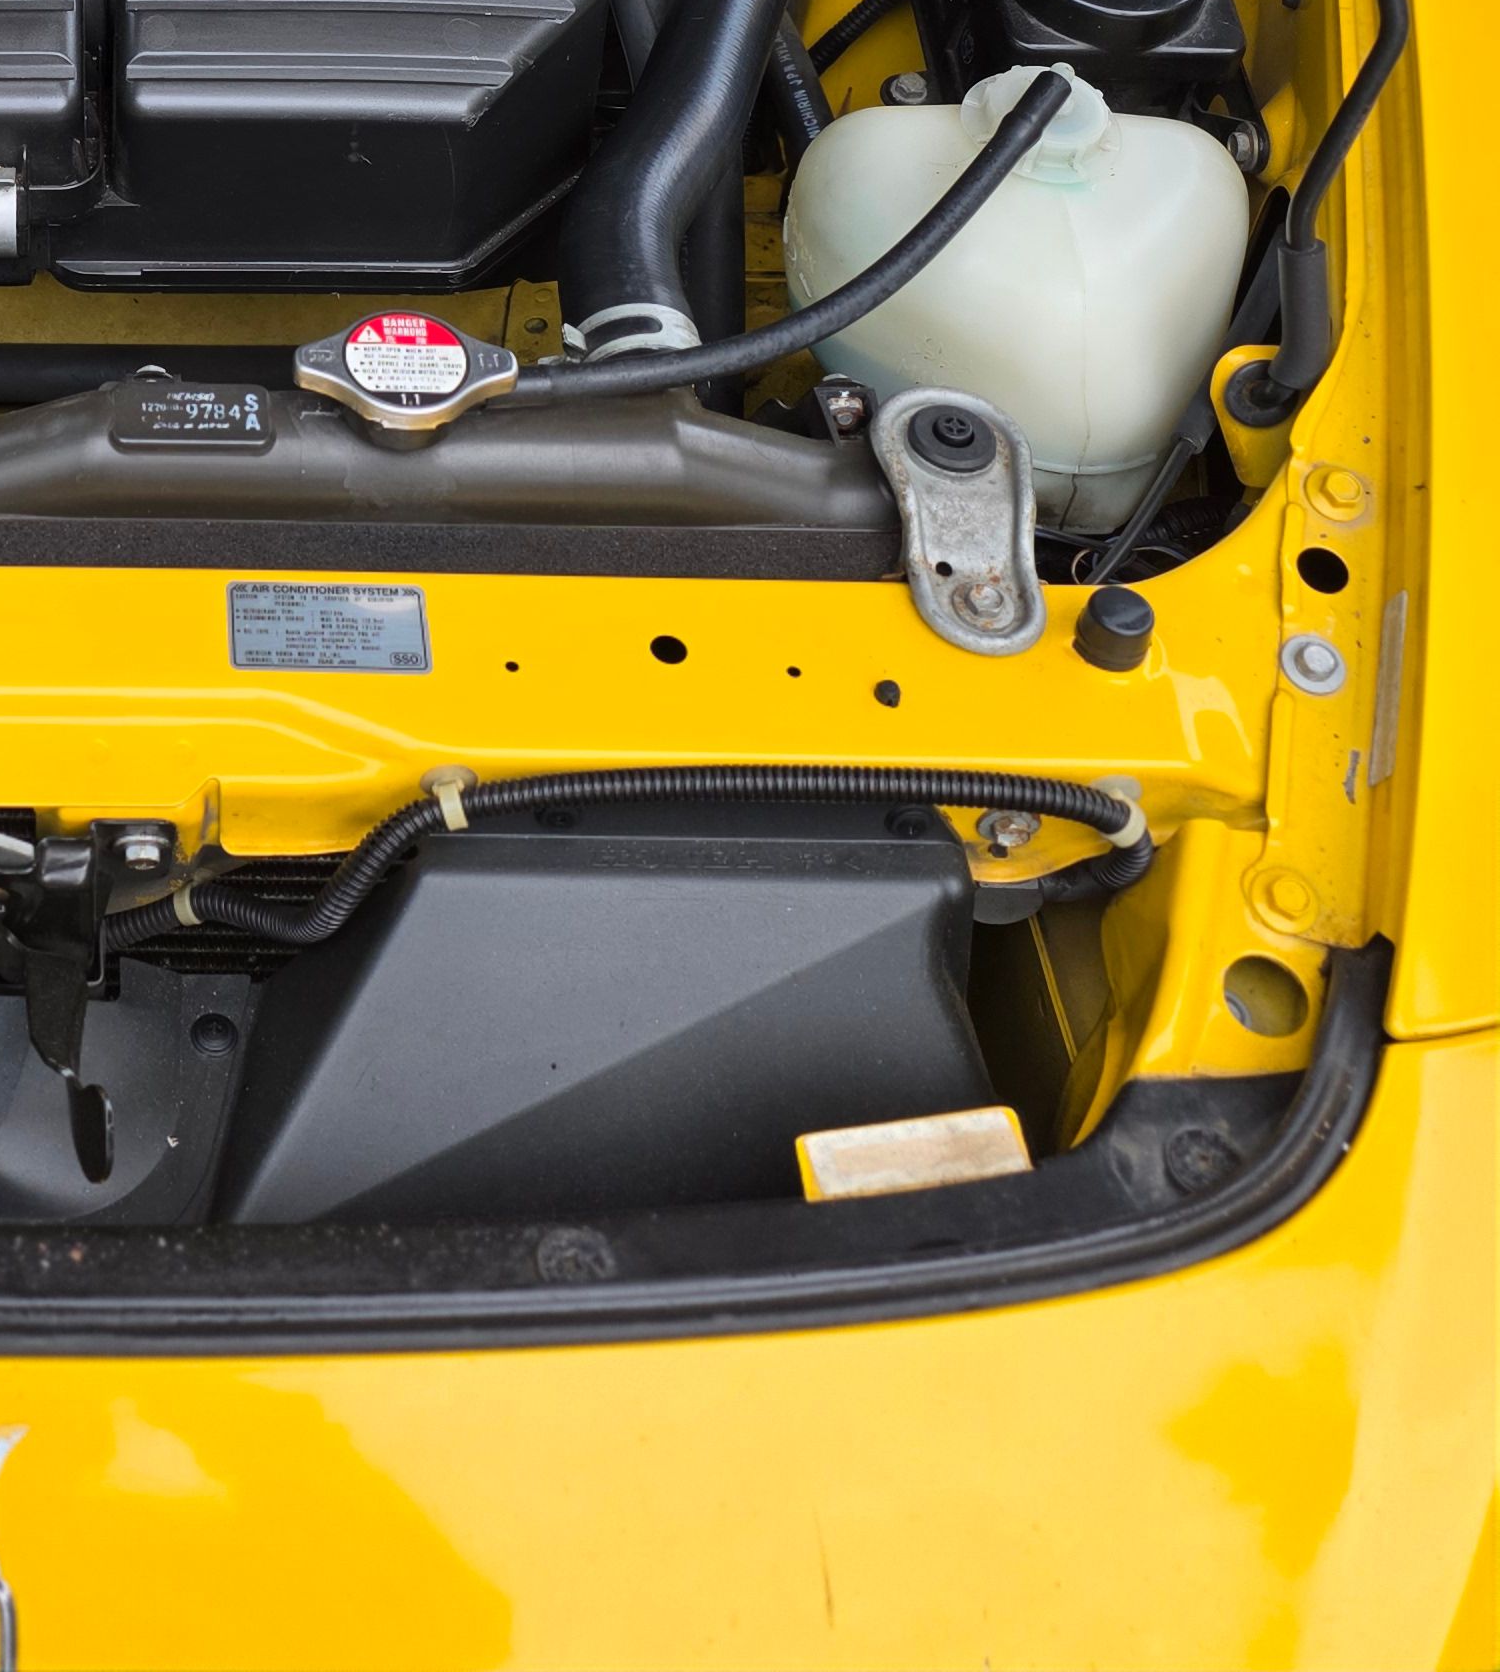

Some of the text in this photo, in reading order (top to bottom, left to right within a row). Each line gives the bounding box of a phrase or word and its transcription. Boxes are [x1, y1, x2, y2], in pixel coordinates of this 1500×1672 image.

[793, 89, 821, 139] NICHIRIN
[382, 317, 426, 327] DANGER
[401, 393, 421, 406] 1.1
[251, 585, 399, 597] AIR CONDITIONER SYSTEM
